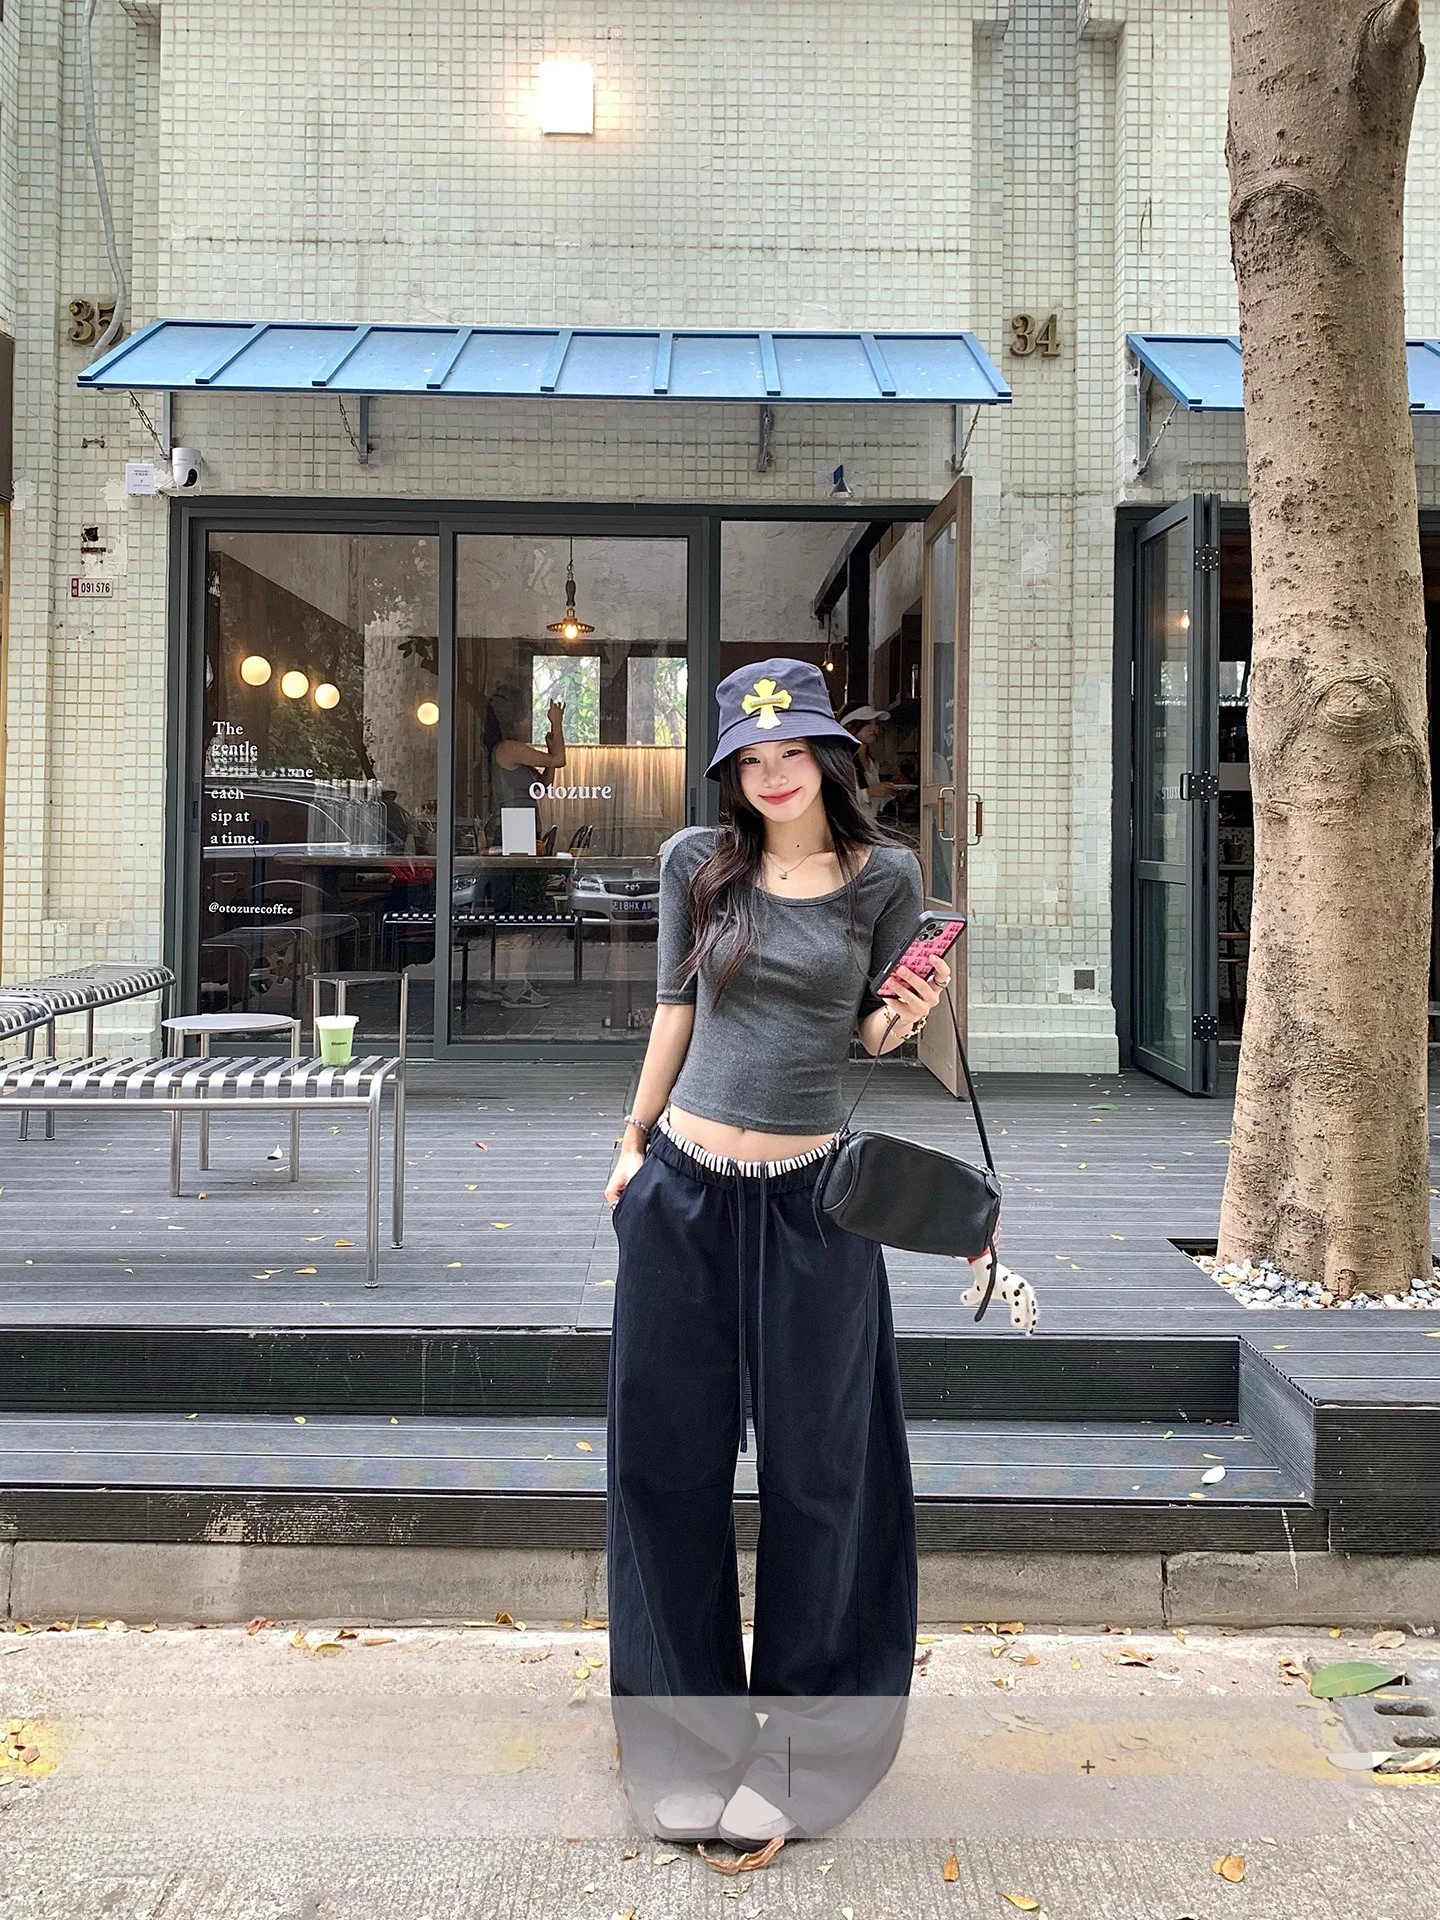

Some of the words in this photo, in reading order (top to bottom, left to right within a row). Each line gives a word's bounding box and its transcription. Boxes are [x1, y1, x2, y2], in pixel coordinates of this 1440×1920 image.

[1010, 314, 1061, 357] 34
[212, 721, 244, 735] The
[211, 741, 258, 758] gentle
[210, 787, 244, 800] each
[529, 782, 612, 800] Otozure
[211, 809, 232, 826] sip
[235, 811, 250, 822] at
[210, 835, 218, 844] a
[221, 832, 259, 844] time.
[208, 902, 294, 914] @otozurecoffee
